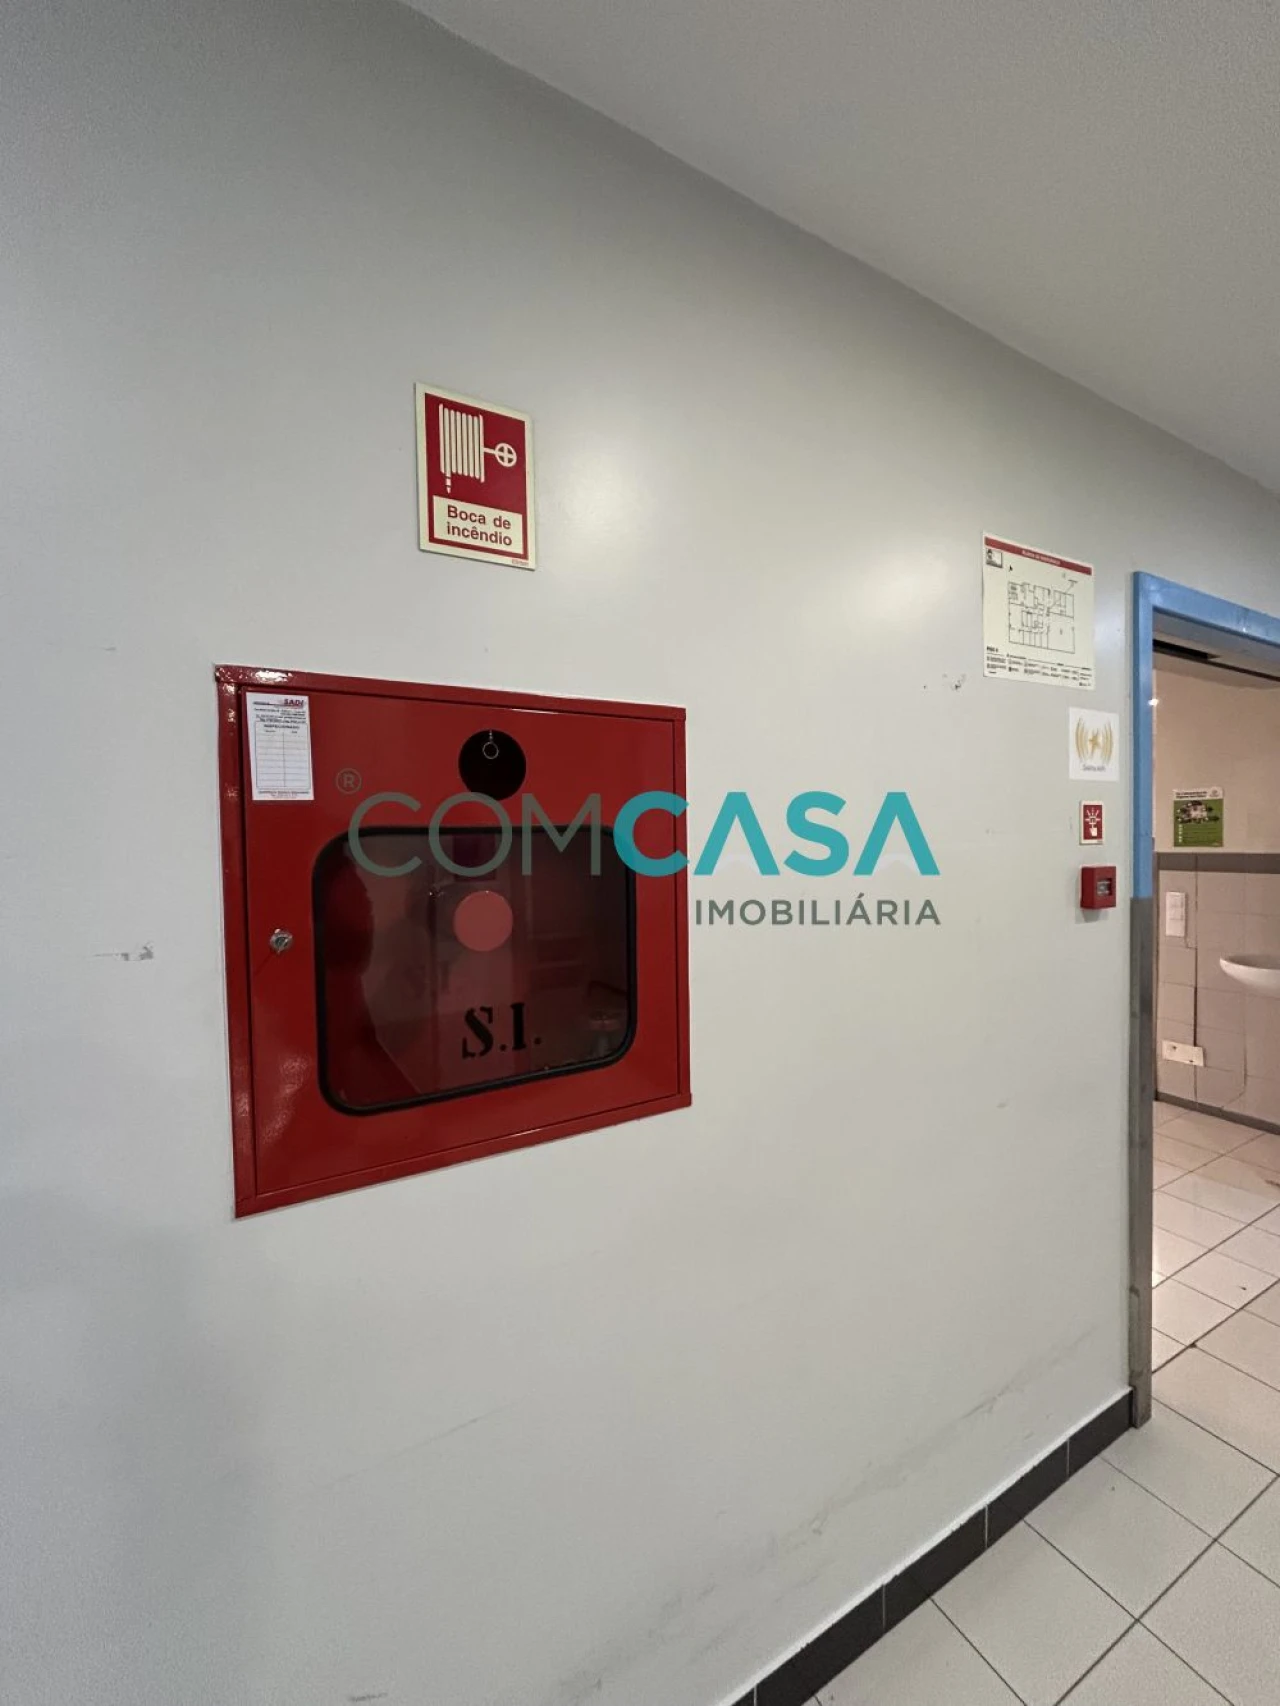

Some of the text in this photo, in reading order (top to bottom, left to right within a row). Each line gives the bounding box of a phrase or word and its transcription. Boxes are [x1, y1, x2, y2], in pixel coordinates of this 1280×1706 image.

[448, 505, 512, 530] Boca de
[447, 522, 512, 546] incêndio
[461, 1002, 542, 1060] S.I.
